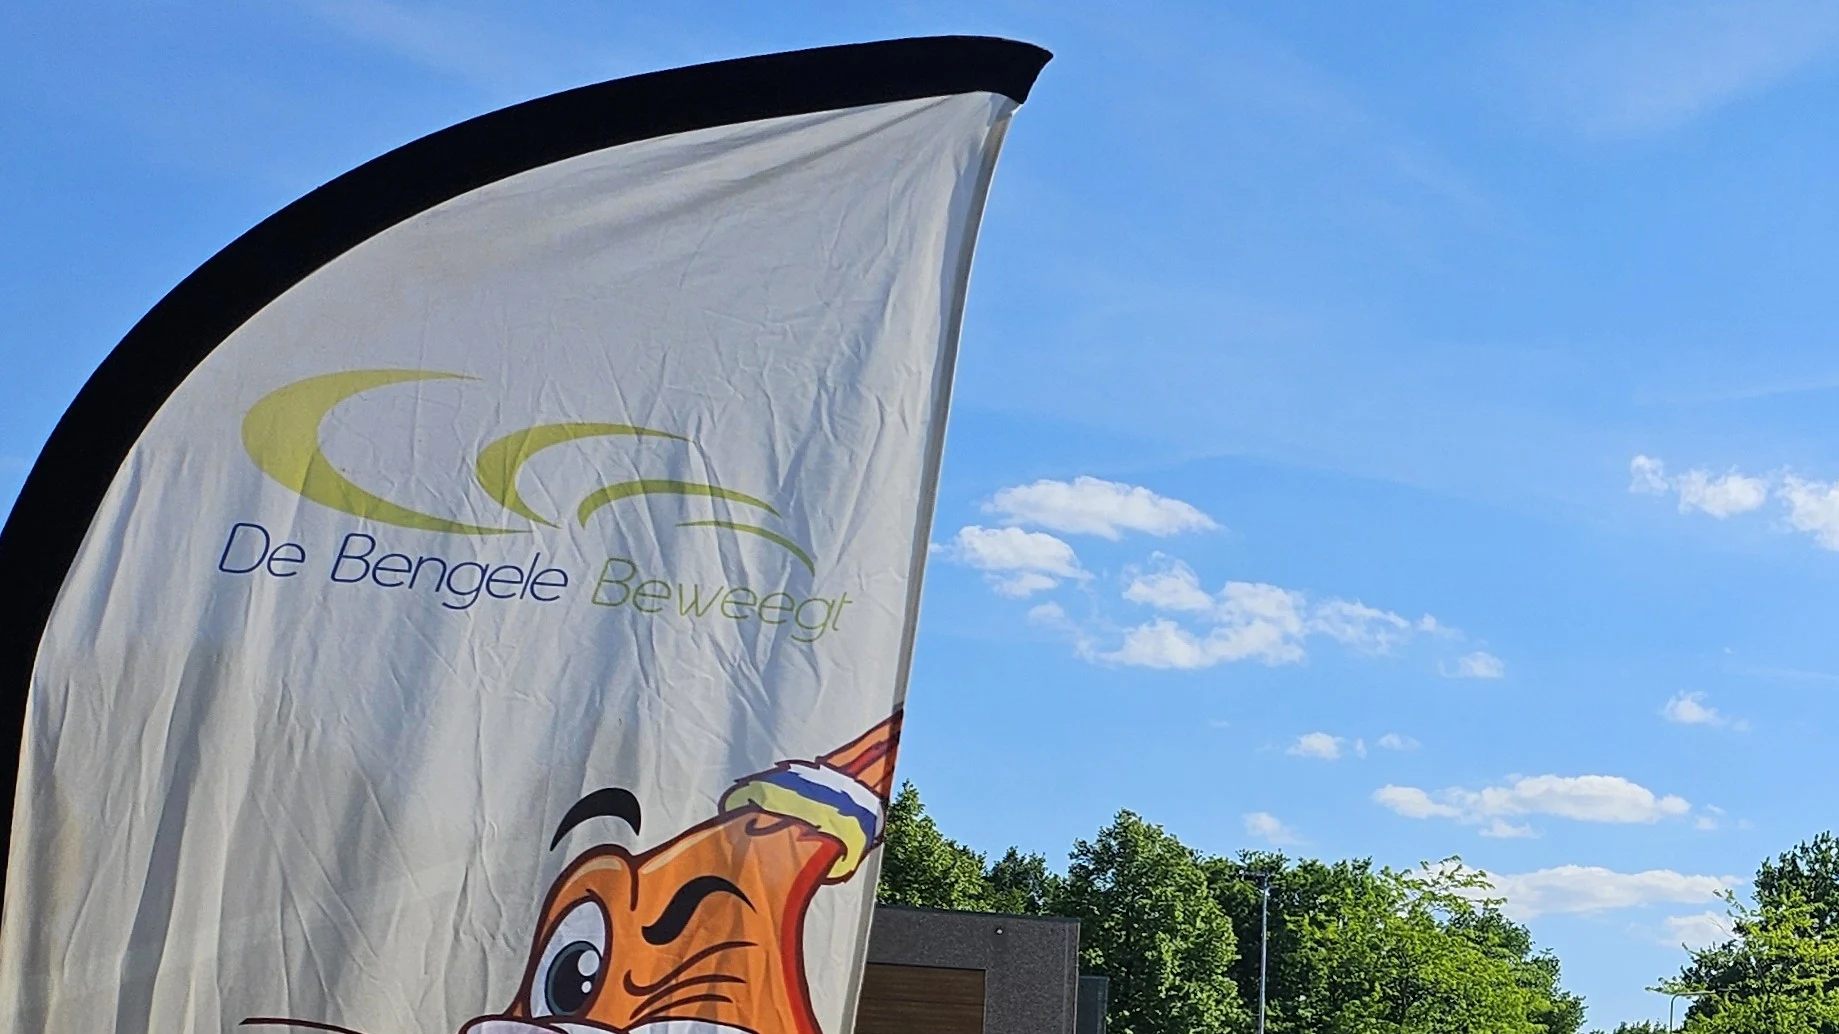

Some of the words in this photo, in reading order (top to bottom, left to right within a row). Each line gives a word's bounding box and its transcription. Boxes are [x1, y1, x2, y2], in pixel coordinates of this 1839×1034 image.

[219, 522, 305, 577] De
[330, 532, 569, 609] Bengele
[590, 556, 854, 642] Beweegt
